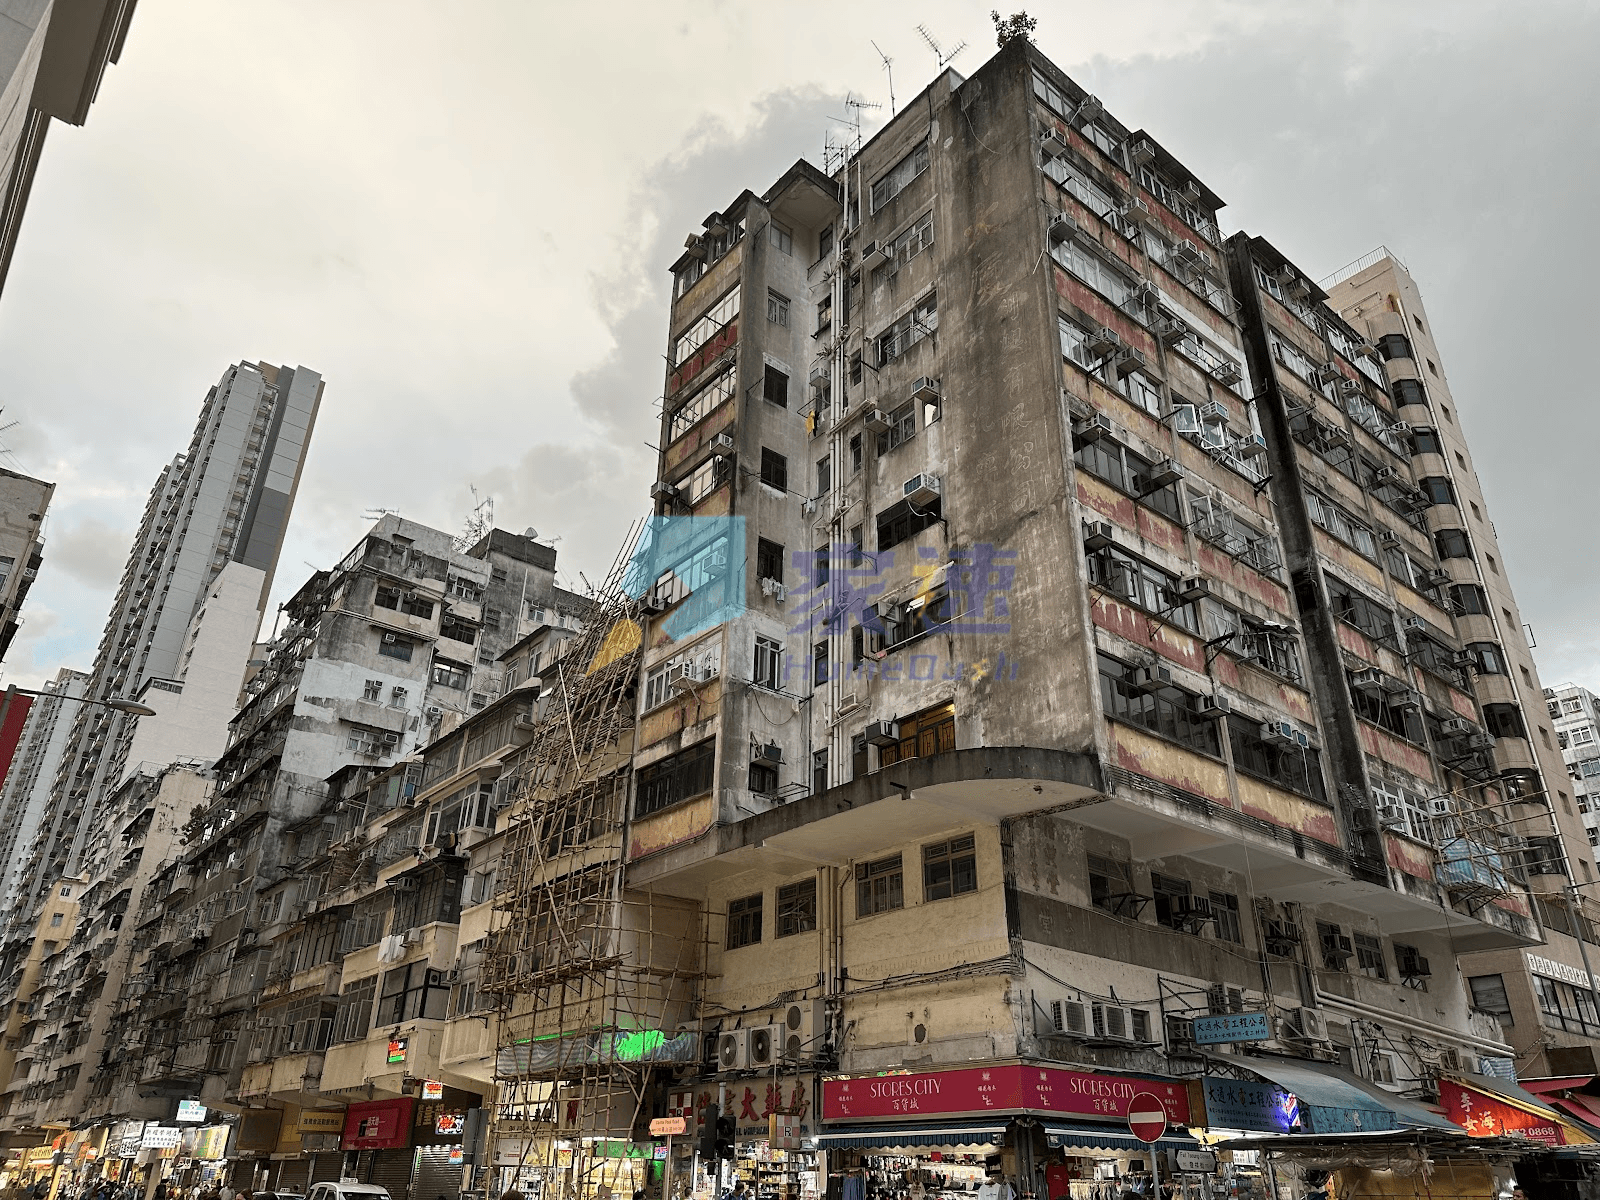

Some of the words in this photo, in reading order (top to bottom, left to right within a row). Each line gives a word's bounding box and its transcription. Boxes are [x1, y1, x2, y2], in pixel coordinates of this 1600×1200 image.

[1196, 1016, 1267, 1032] 大通水電工程公司
[870, 1079, 912, 1098] STORES
[914, 1078, 942, 1095] CITY
[1070, 1077, 1109, 1097] STORES
[1112, 1081, 1137, 1099] CITY
[1528, 1127, 1555, 1136] 0868
